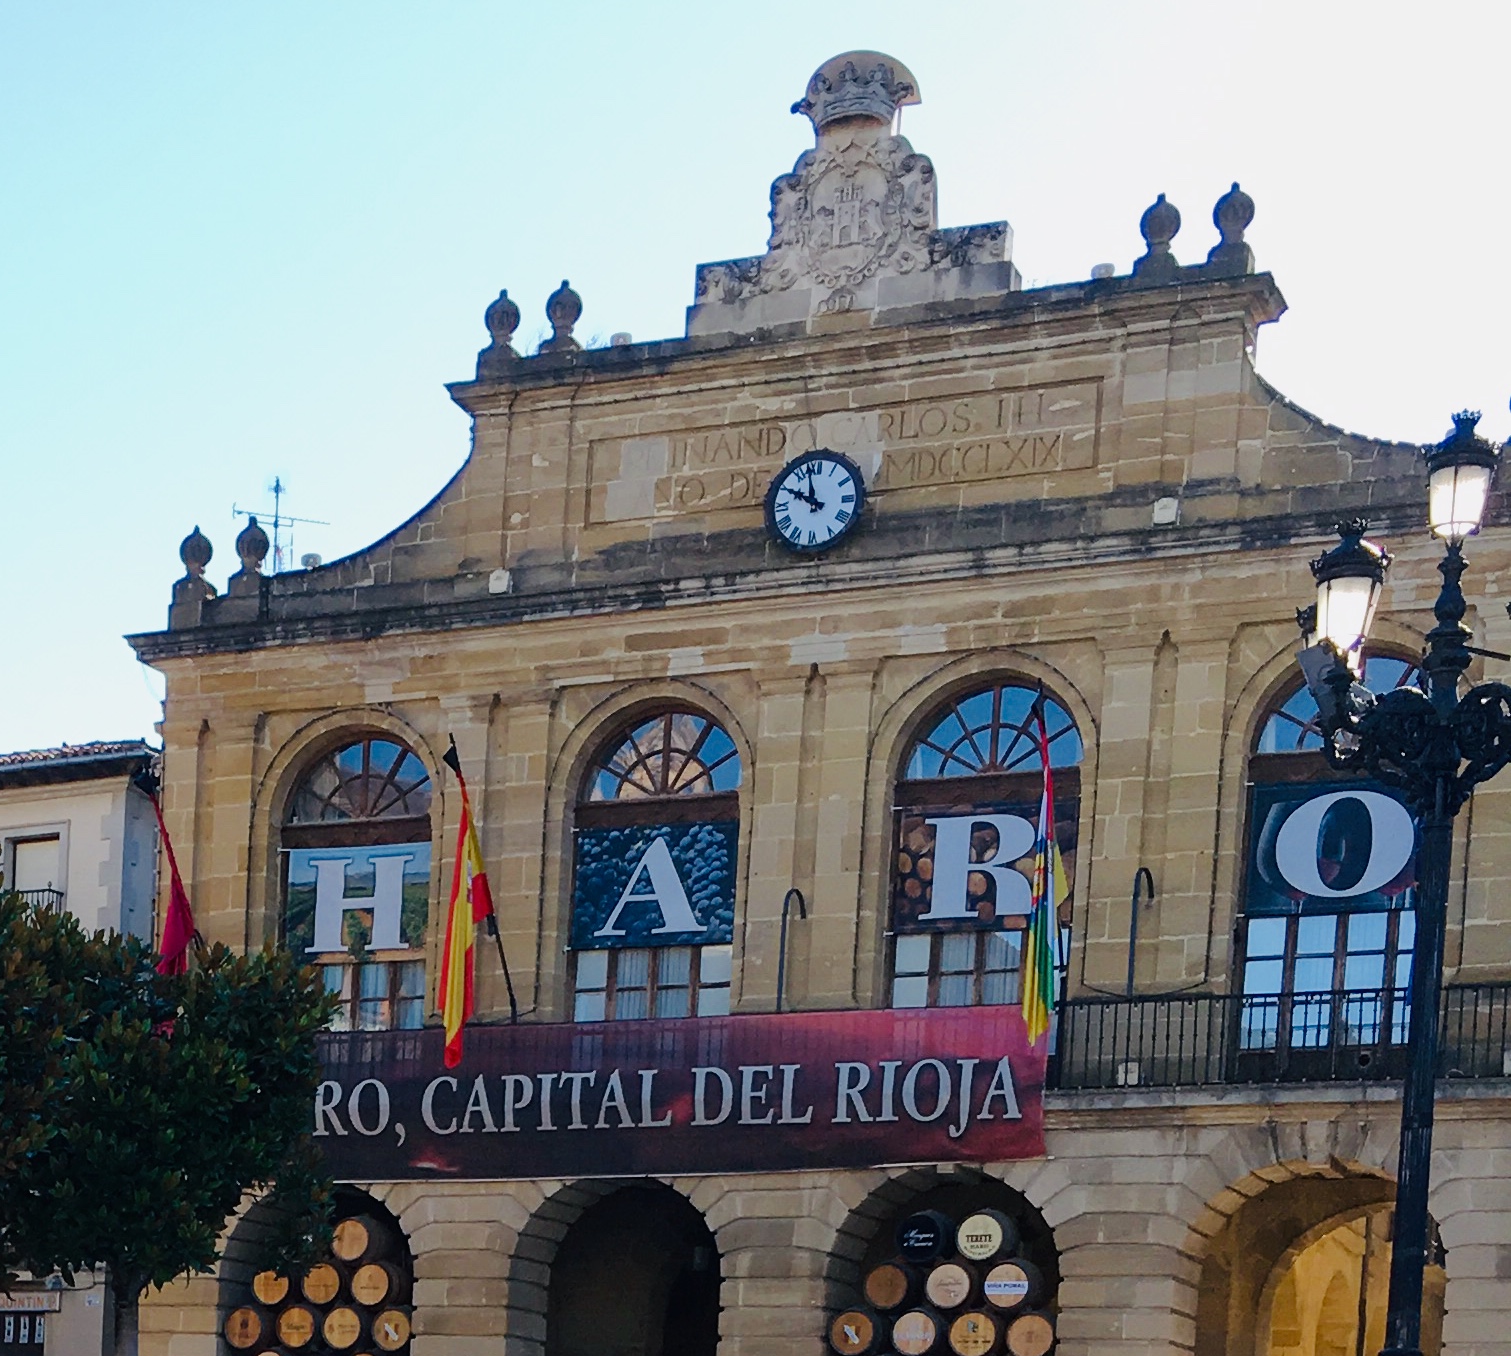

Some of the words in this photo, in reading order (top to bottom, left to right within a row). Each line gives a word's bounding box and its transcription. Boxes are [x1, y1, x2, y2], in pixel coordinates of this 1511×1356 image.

[728, 469, 772, 502] DE
[304, 853, 414, 954] H
[593, 836, 708, 937] A
[917, 813, 1037, 921] R
[1275, 789, 1415, 898] O
[421, 1067, 673, 1136] CAPITAL
[690, 1063, 814, 1126] DEL
[831, 1054, 1023, 1139] RIOJA
